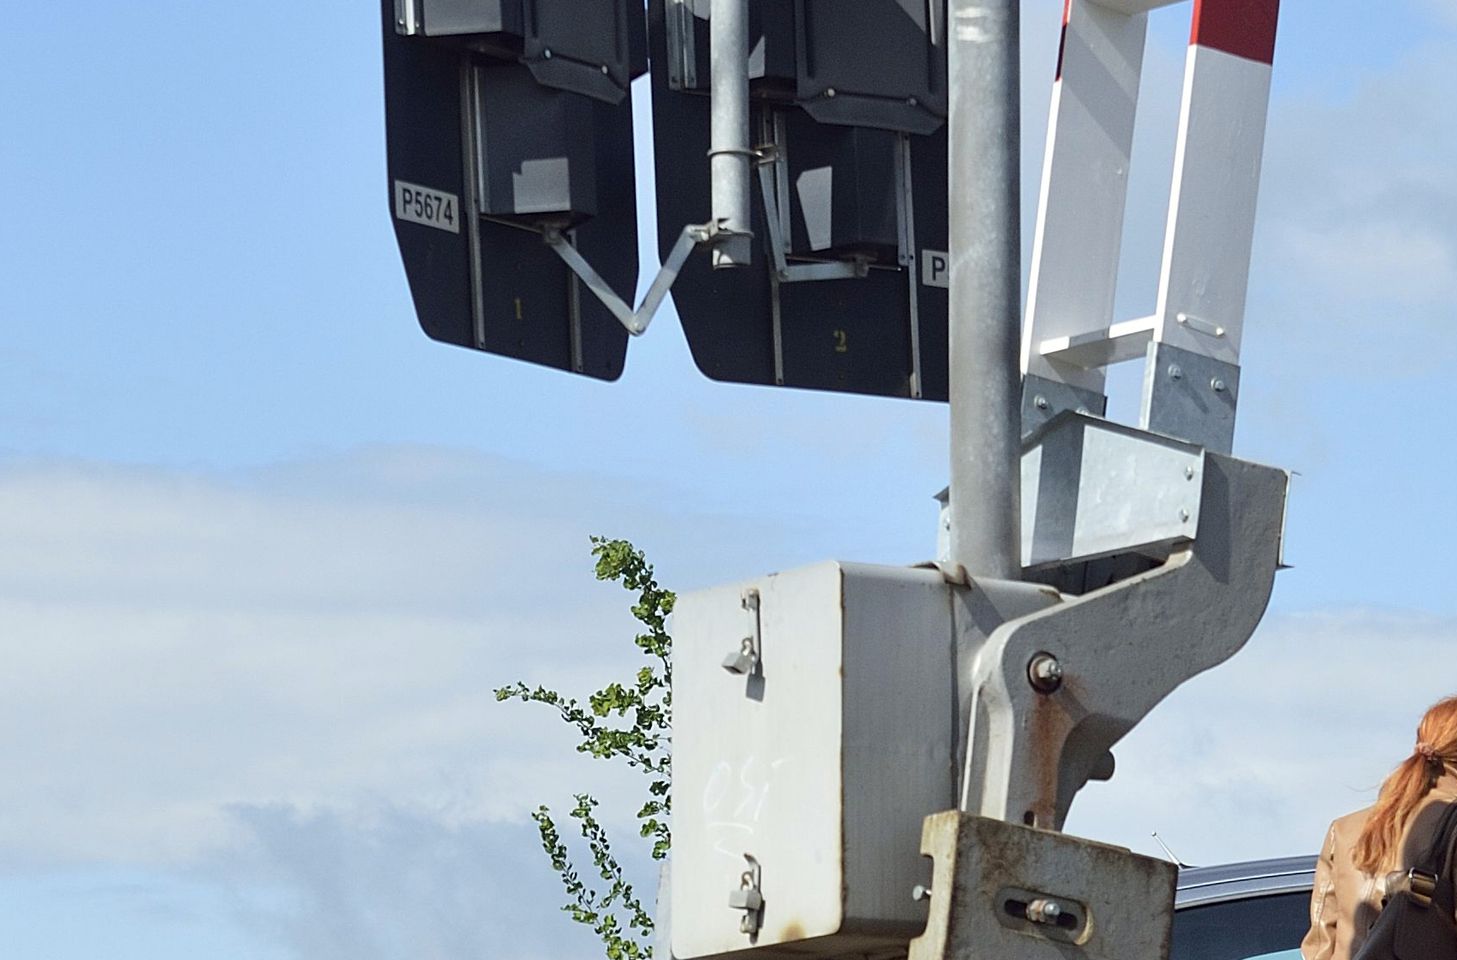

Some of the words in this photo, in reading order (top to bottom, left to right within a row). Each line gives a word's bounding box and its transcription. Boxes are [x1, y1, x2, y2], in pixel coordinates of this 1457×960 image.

[402, 187, 453, 226] P5674
[514, 298, 522, 320] 1
[833, 329, 847, 352] 2
